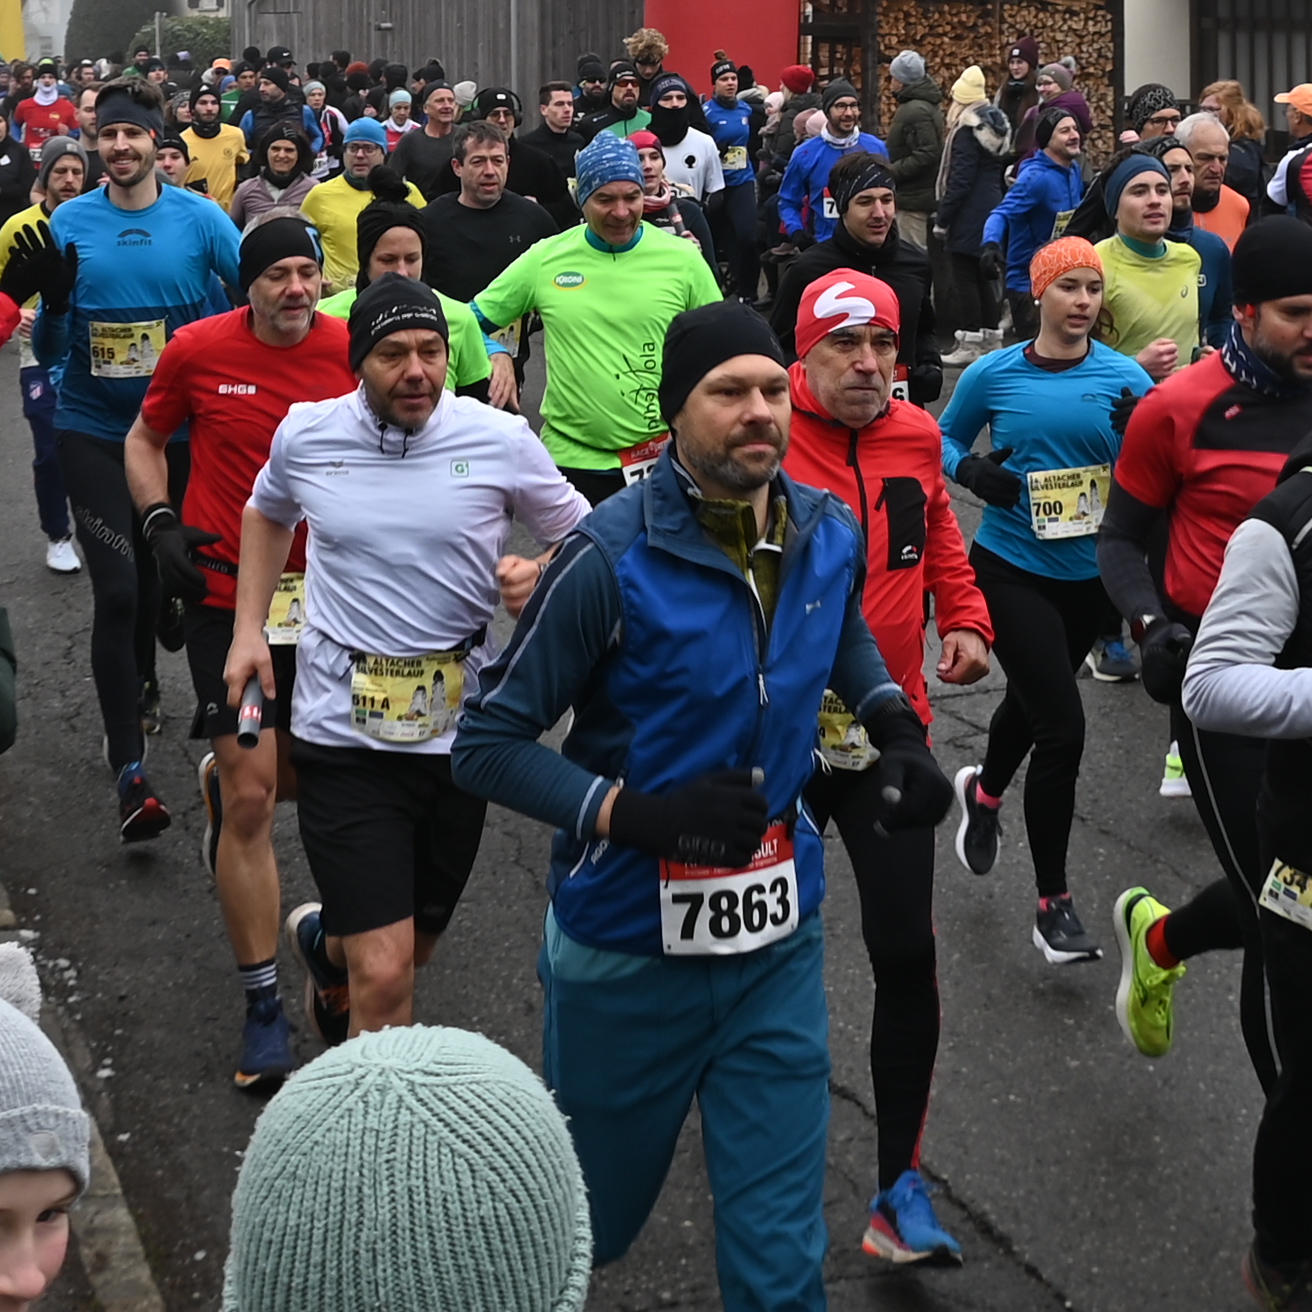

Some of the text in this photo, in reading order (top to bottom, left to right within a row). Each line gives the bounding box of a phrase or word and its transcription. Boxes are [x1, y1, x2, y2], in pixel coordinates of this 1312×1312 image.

[92, 345, 116, 360] 615
[1032, 500, 1064, 517] 700
[355, 663, 425, 678] SILVESTERLAUF
[373, 657, 423, 669] ALTACHER
[380, 696, 391, 711] A
[671, 875, 791, 941] 7863
